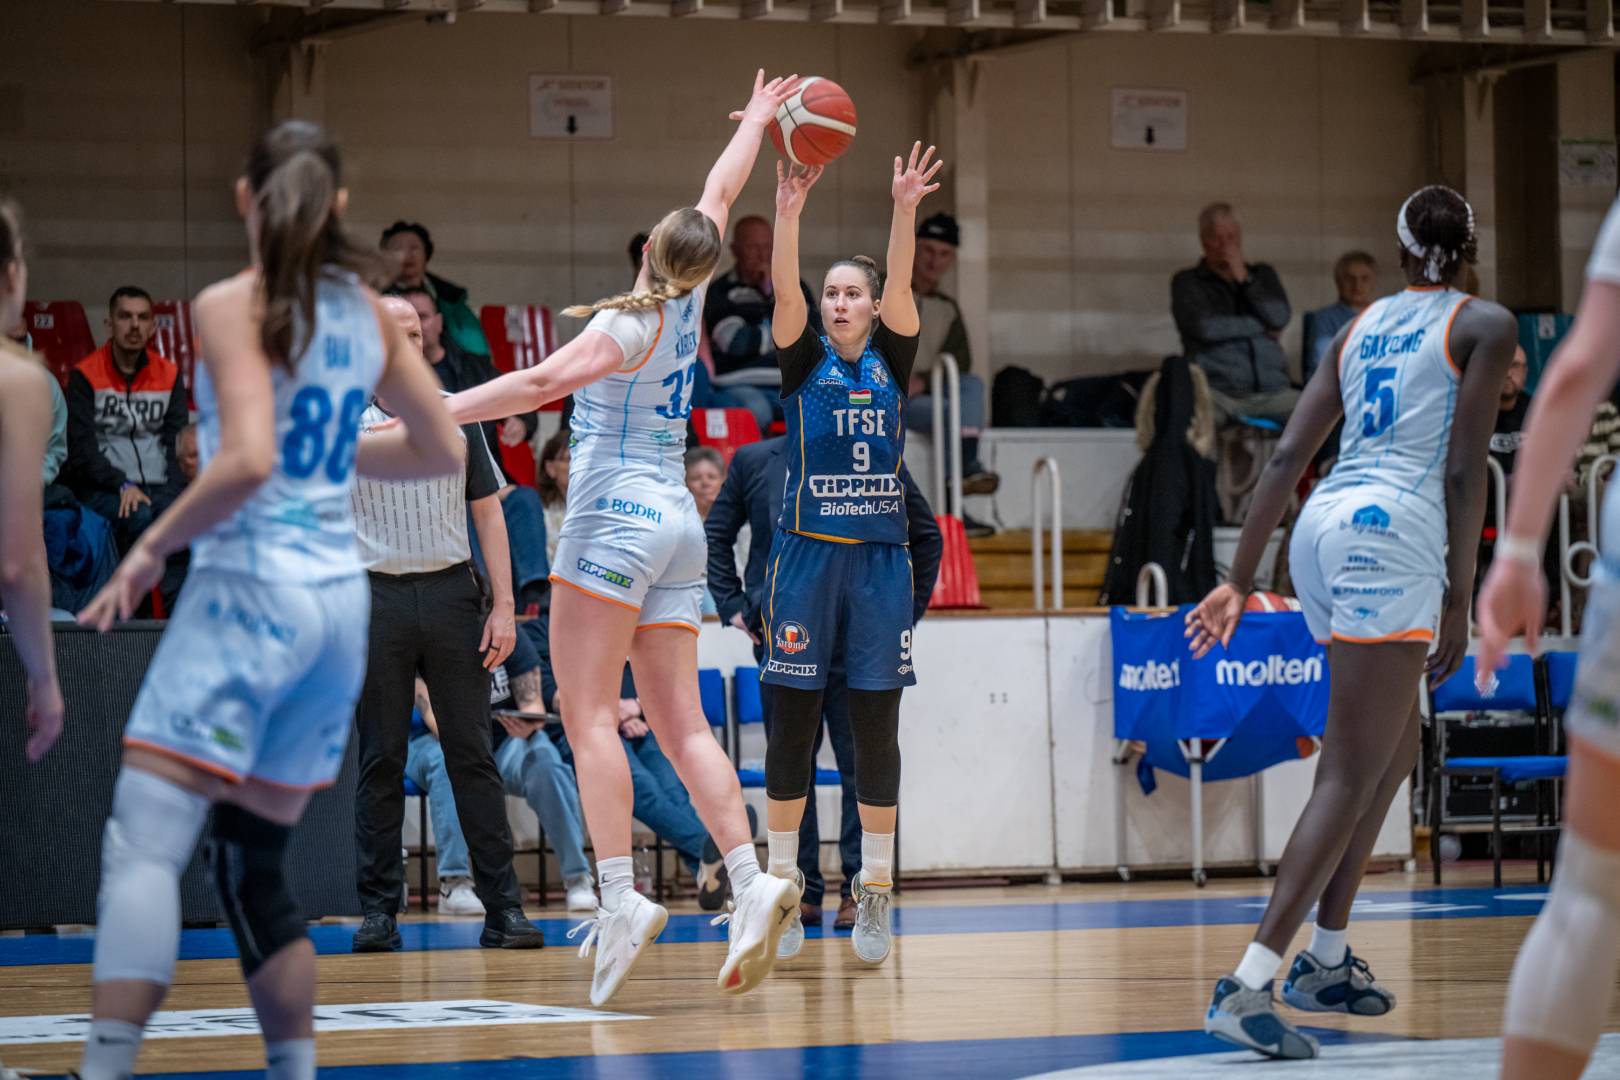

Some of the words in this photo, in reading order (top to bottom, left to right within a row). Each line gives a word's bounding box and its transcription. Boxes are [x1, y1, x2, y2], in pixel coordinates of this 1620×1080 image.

[1362, 366, 1397, 438] 5
[832, 409, 886, 437] TFSE
[852, 441, 871, 472] 9
[611, 498, 662, 525] BODRI
[820, 500, 900, 516] BioTechUSA
[900, 629, 912, 660] 9
[1216, 655, 1322, 687] molten
